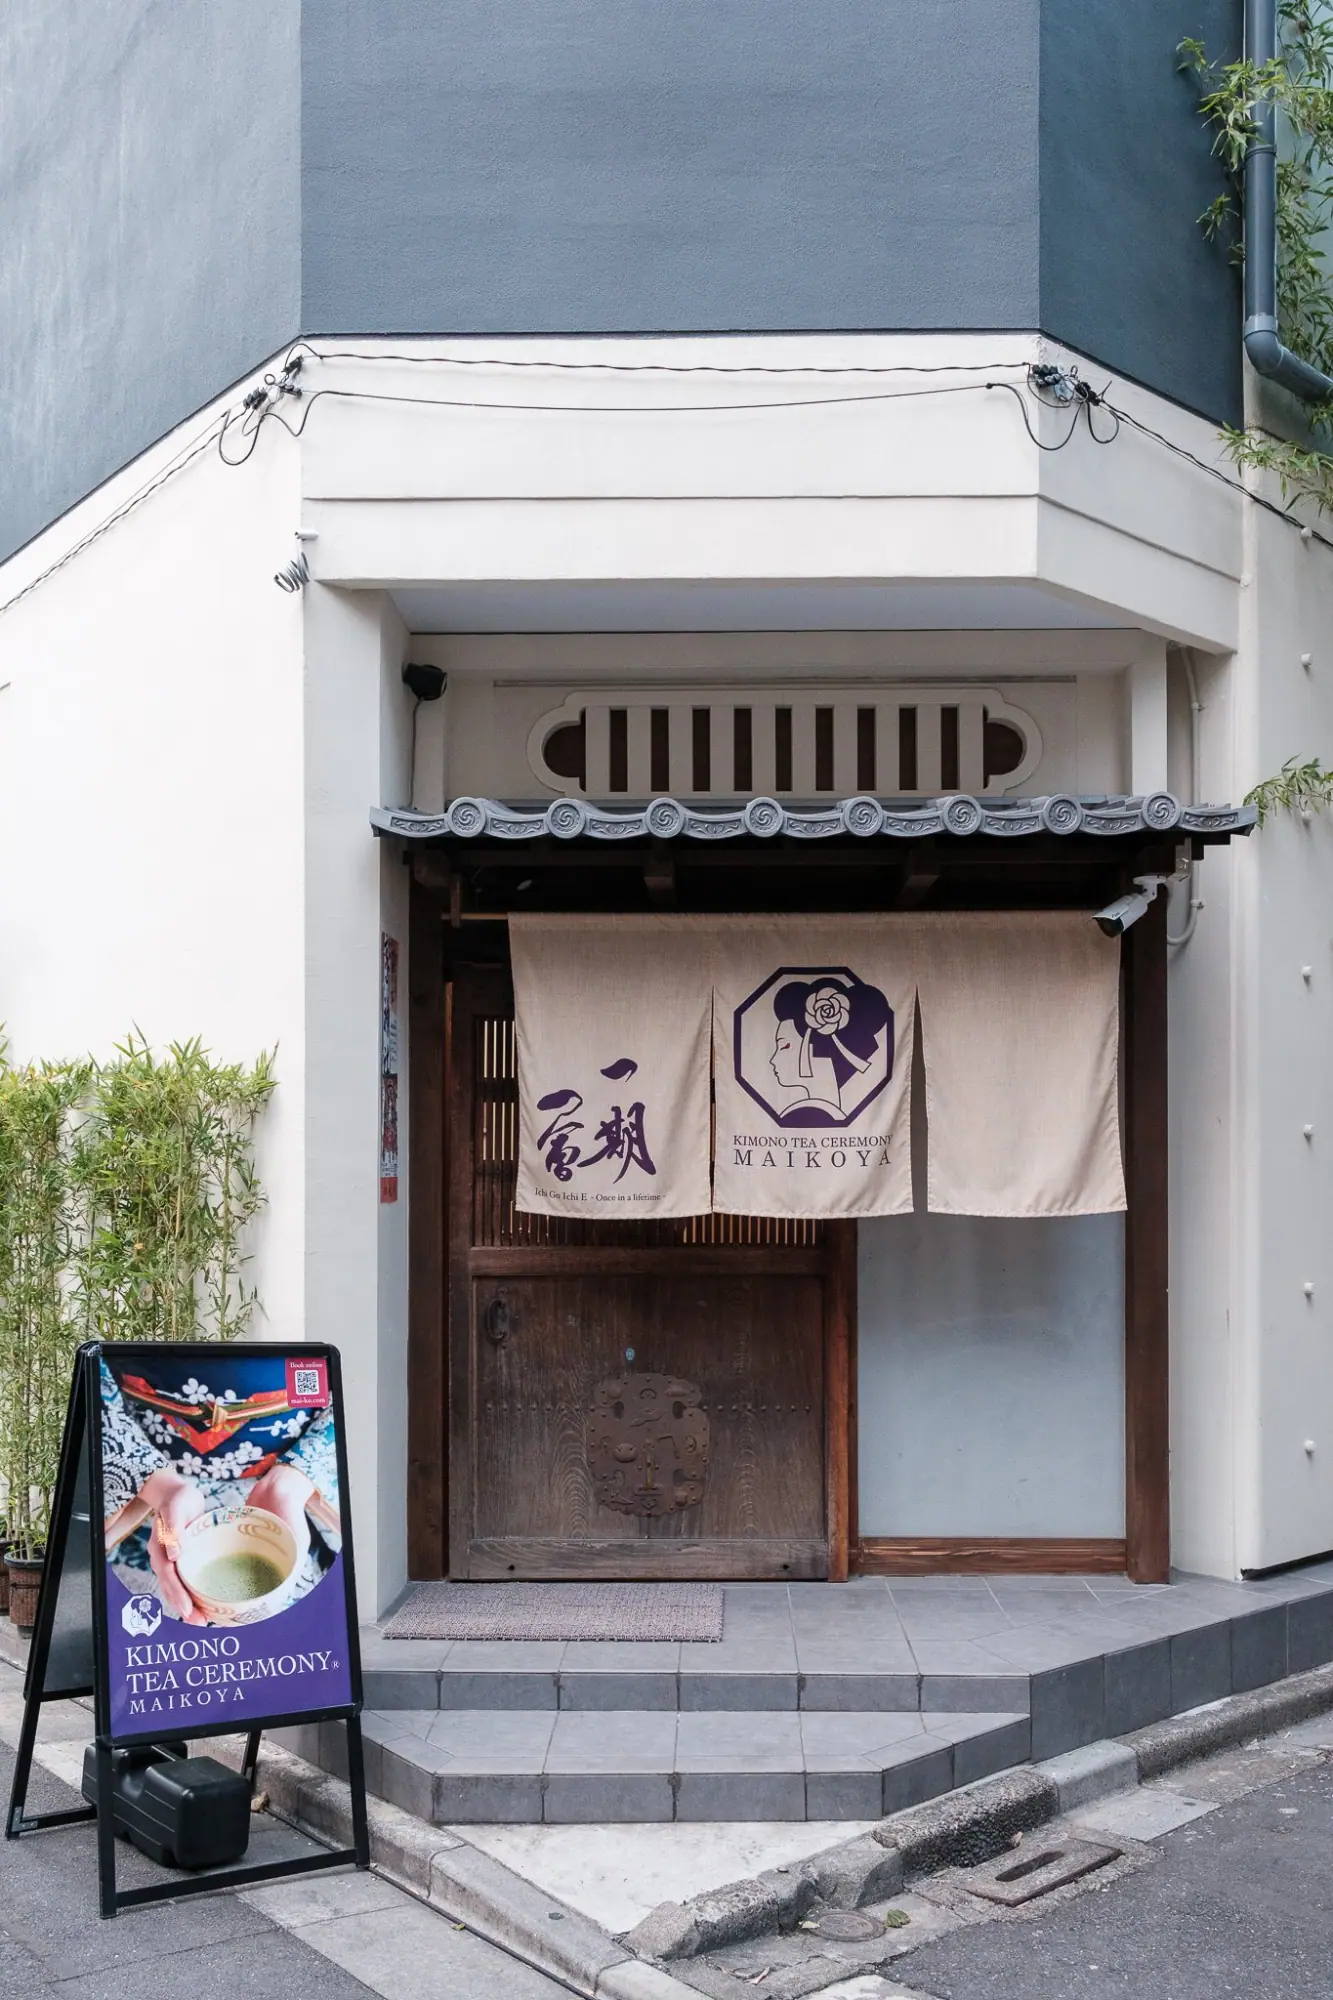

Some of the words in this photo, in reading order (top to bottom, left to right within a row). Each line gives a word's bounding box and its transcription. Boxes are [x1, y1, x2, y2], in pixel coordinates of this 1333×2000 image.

[733, 1135, 788, 1148] KIMONO
[791, 1137, 817, 1148] TEA
[821, 1134, 893, 1148] CEREMONY
[733, 1149, 892, 1168] MAIKOYA
[535, 1188, 548, 1197] Ichi
[549, 1190, 561, 1199] Go
[563, 1192, 579, 1201] Ichi
[581, 1193, 587, 1201] E
[595, 1193, 616, 1201] Once
[633, 1193, 661, 1201] lifetime
[125, 1636, 240, 1668] KIMONO
[126, 1669, 180, 1695] TEA
[129, 1687, 246, 1715] MAIKOYA
